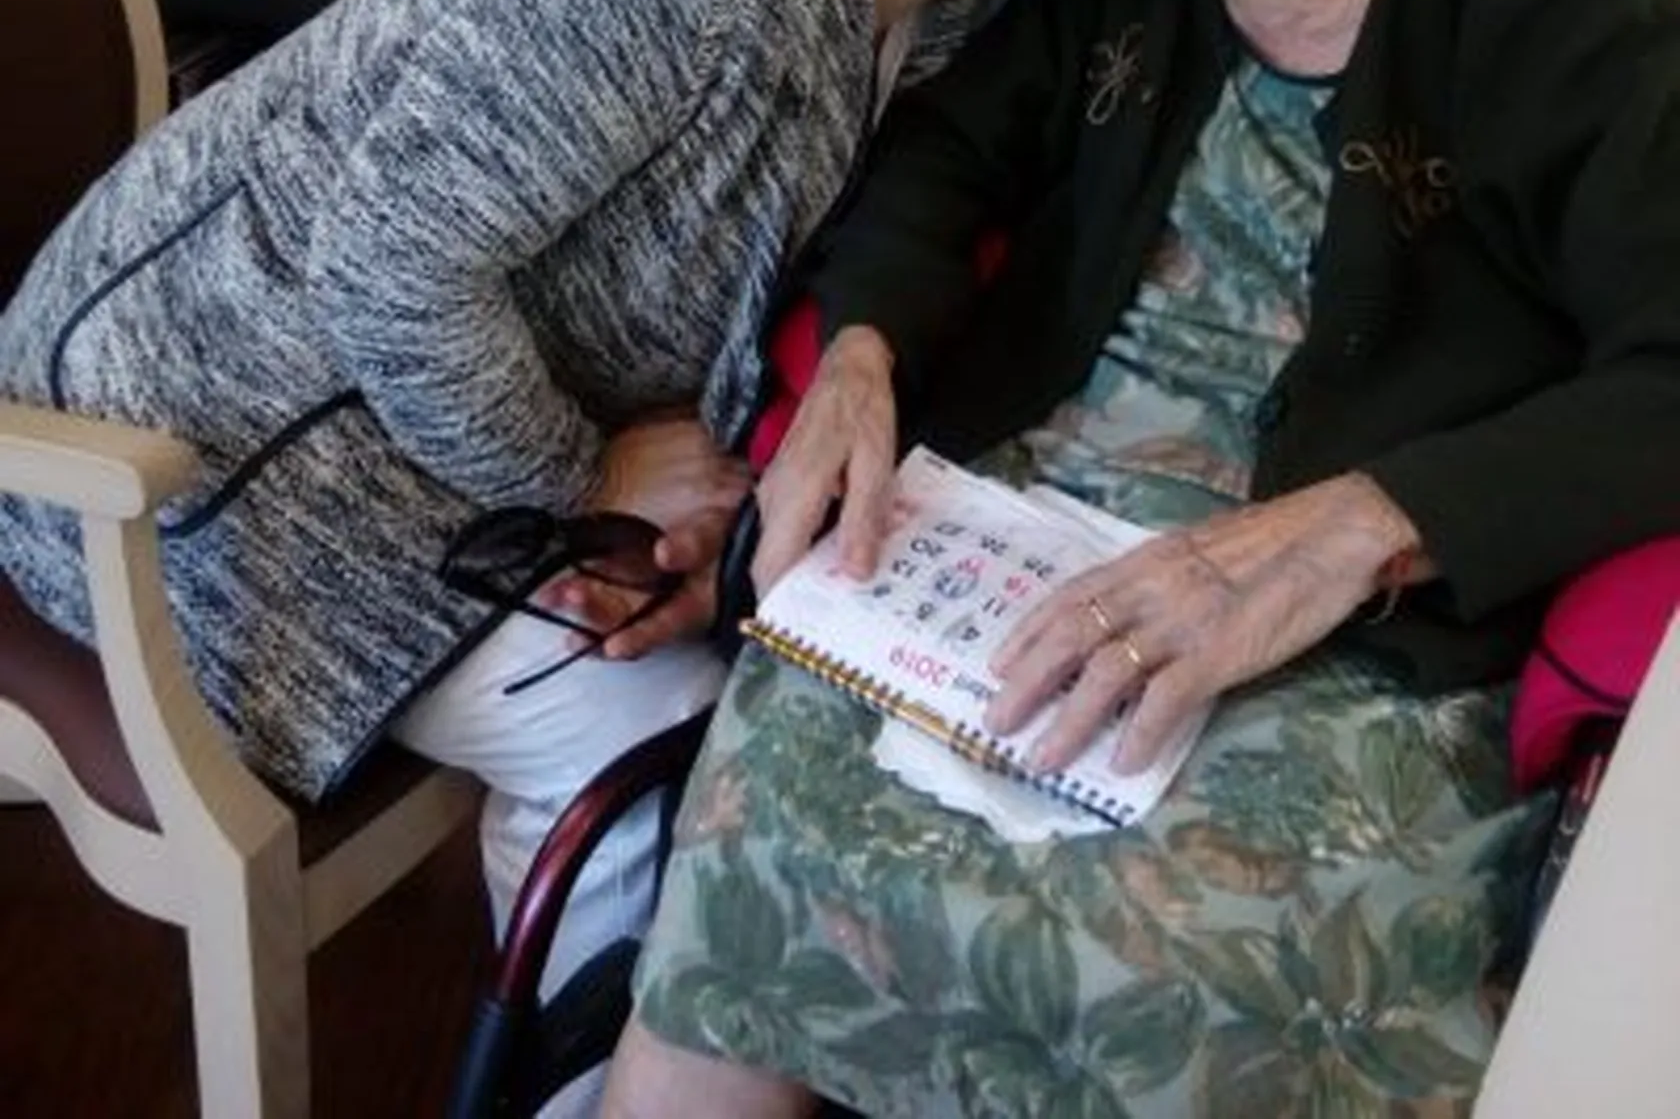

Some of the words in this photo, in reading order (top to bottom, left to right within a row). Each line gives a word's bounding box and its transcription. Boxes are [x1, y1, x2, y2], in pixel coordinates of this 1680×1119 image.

[910, 538, 947, 558] 20
[980, 597, 1007, 617] 11
[889, 647, 950, 688] 2019
